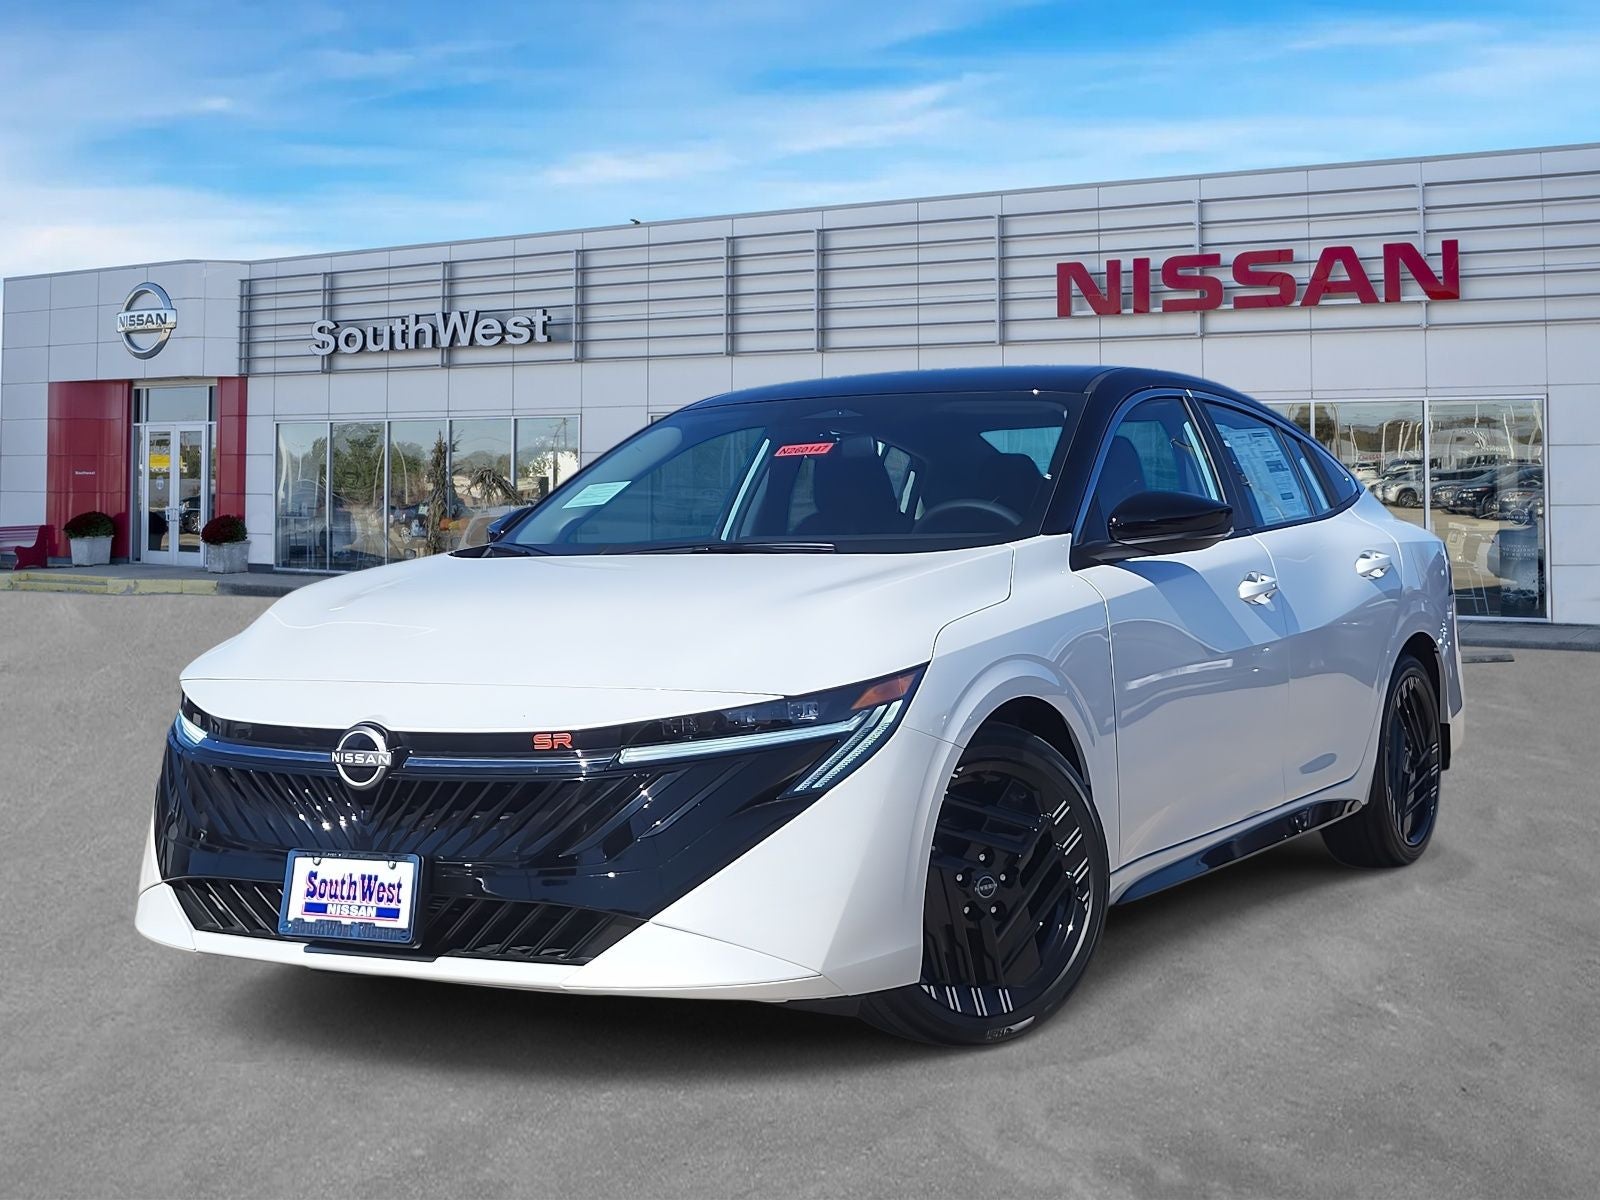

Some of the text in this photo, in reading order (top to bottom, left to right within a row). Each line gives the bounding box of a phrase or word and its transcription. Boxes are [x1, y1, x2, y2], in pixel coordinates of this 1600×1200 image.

[1056, 239, 1460, 318] NISSAN
[118, 312, 168, 328] NISSAN
[309, 308, 551, 356] SouthWest
[778, 445, 829, 455] N260147
[532, 732, 573, 750] SR
[331, 751, 391, 766] NISSAN
[304, 870, 403, 904] SouthWest
[326, 903, 377, 917] NISSAN
